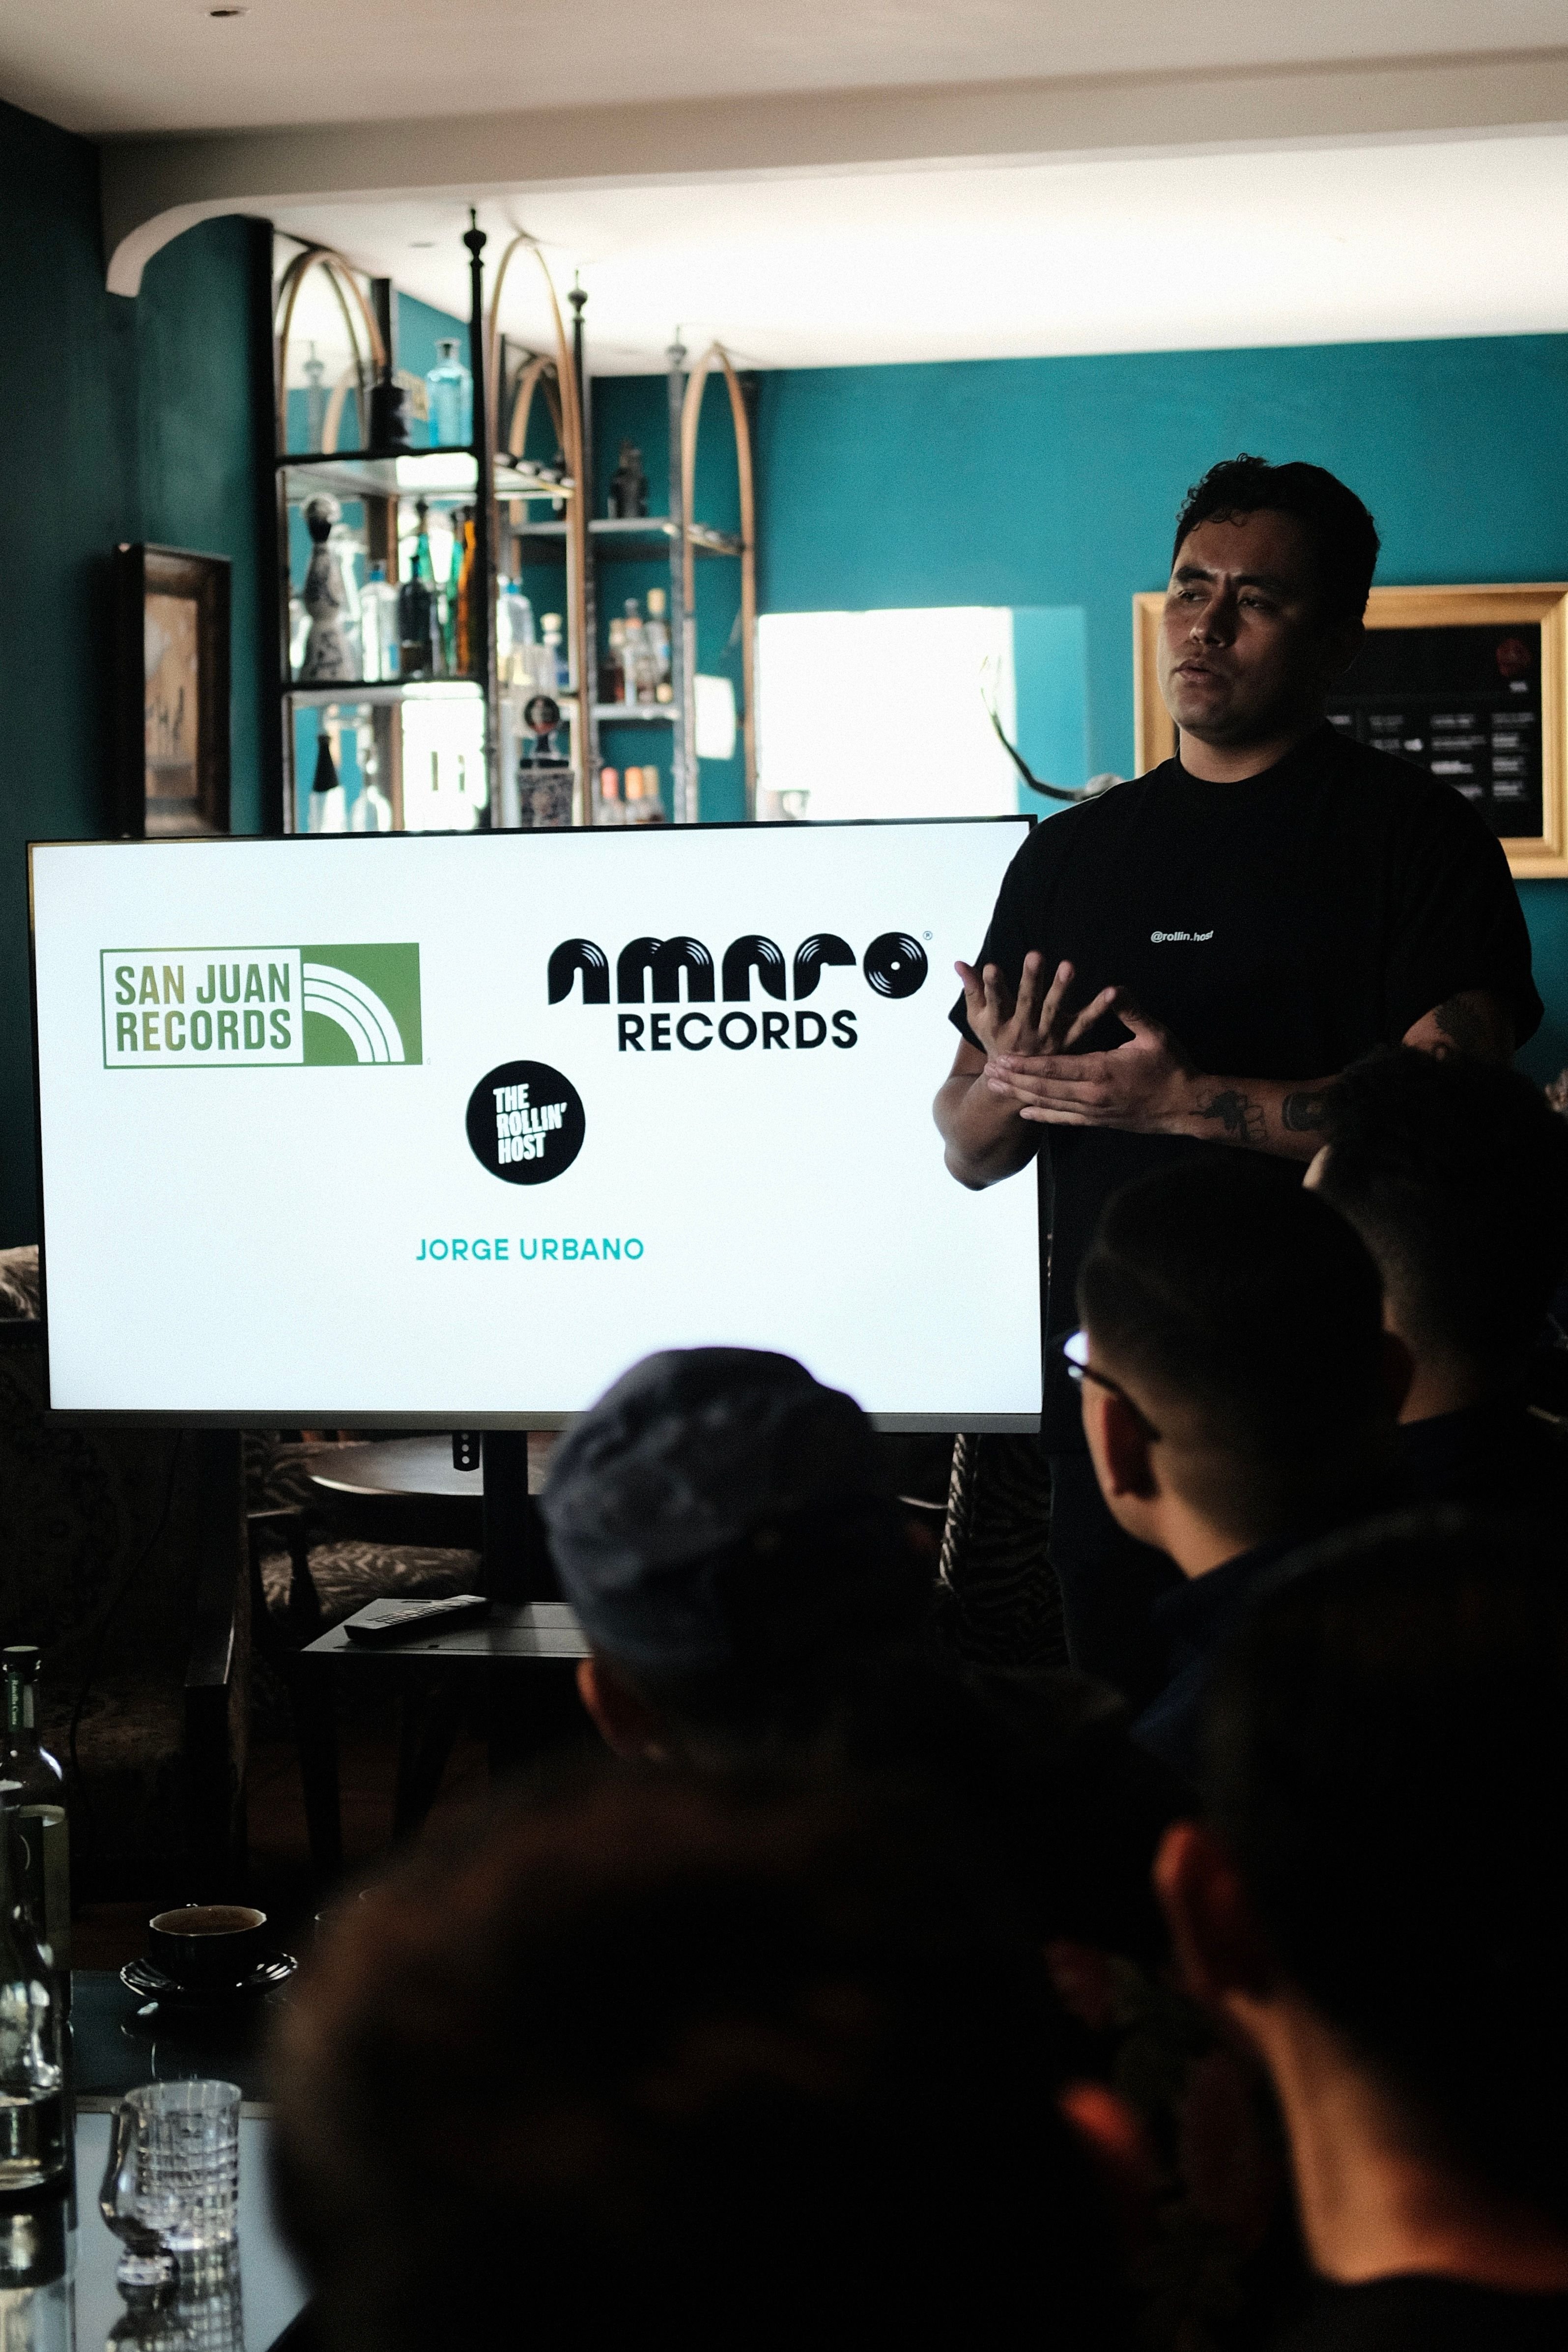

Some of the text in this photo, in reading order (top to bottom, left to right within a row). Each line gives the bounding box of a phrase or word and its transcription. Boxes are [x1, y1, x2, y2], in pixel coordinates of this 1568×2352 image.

[115, 963, 290, 1005] SAN JUAN
[116, 1009, 291, 1051] RECORDS
[618, 1010, 858, 1051] RECORDS
[493, 1083, 530, 1113] THE
[498, 1132, 546, 1164] HOST
[416, 1238, 644, 1261] JORGE URBANO
